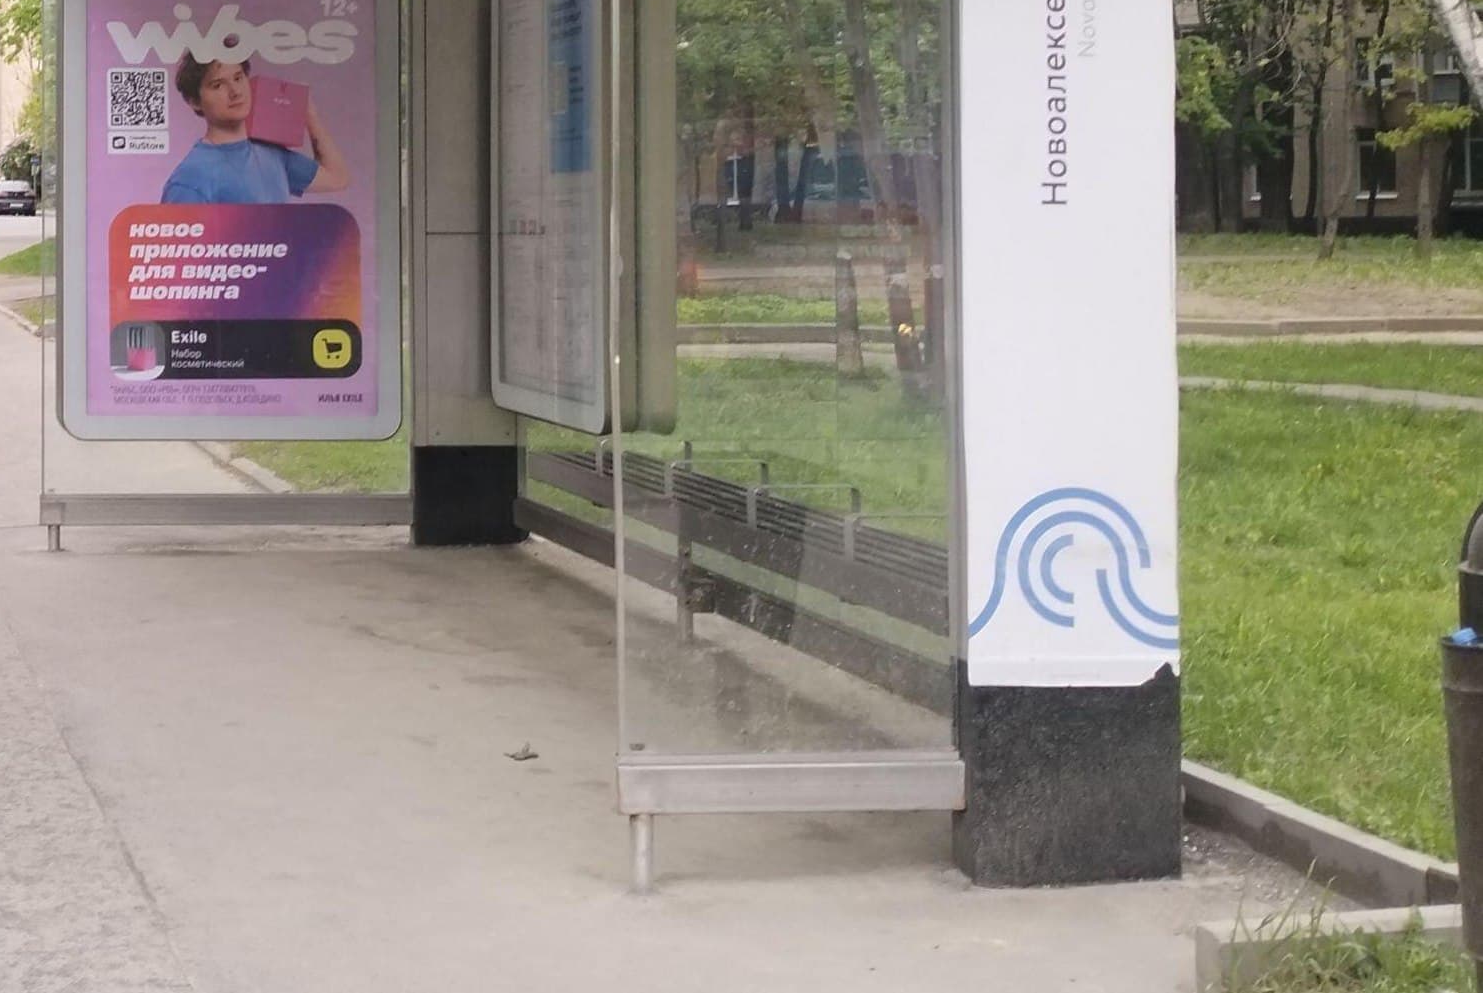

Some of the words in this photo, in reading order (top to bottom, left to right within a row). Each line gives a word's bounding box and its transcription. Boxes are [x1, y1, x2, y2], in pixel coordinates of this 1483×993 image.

[106, 3, 359, 65] wibes
[128, 141, 165, 150] RuStore
[129, 223, 205, 238] новое
[129, 243, 289, 263] приложение
[128, 264, 176, 282] для
[181, 264, 268, 282] видео-
[129, 285, 240, 300] шопинга
[170, 330, 207, 344] Exile
[170, 348, 202, 359] Набор
[170, 358, 245, 369] косметический
